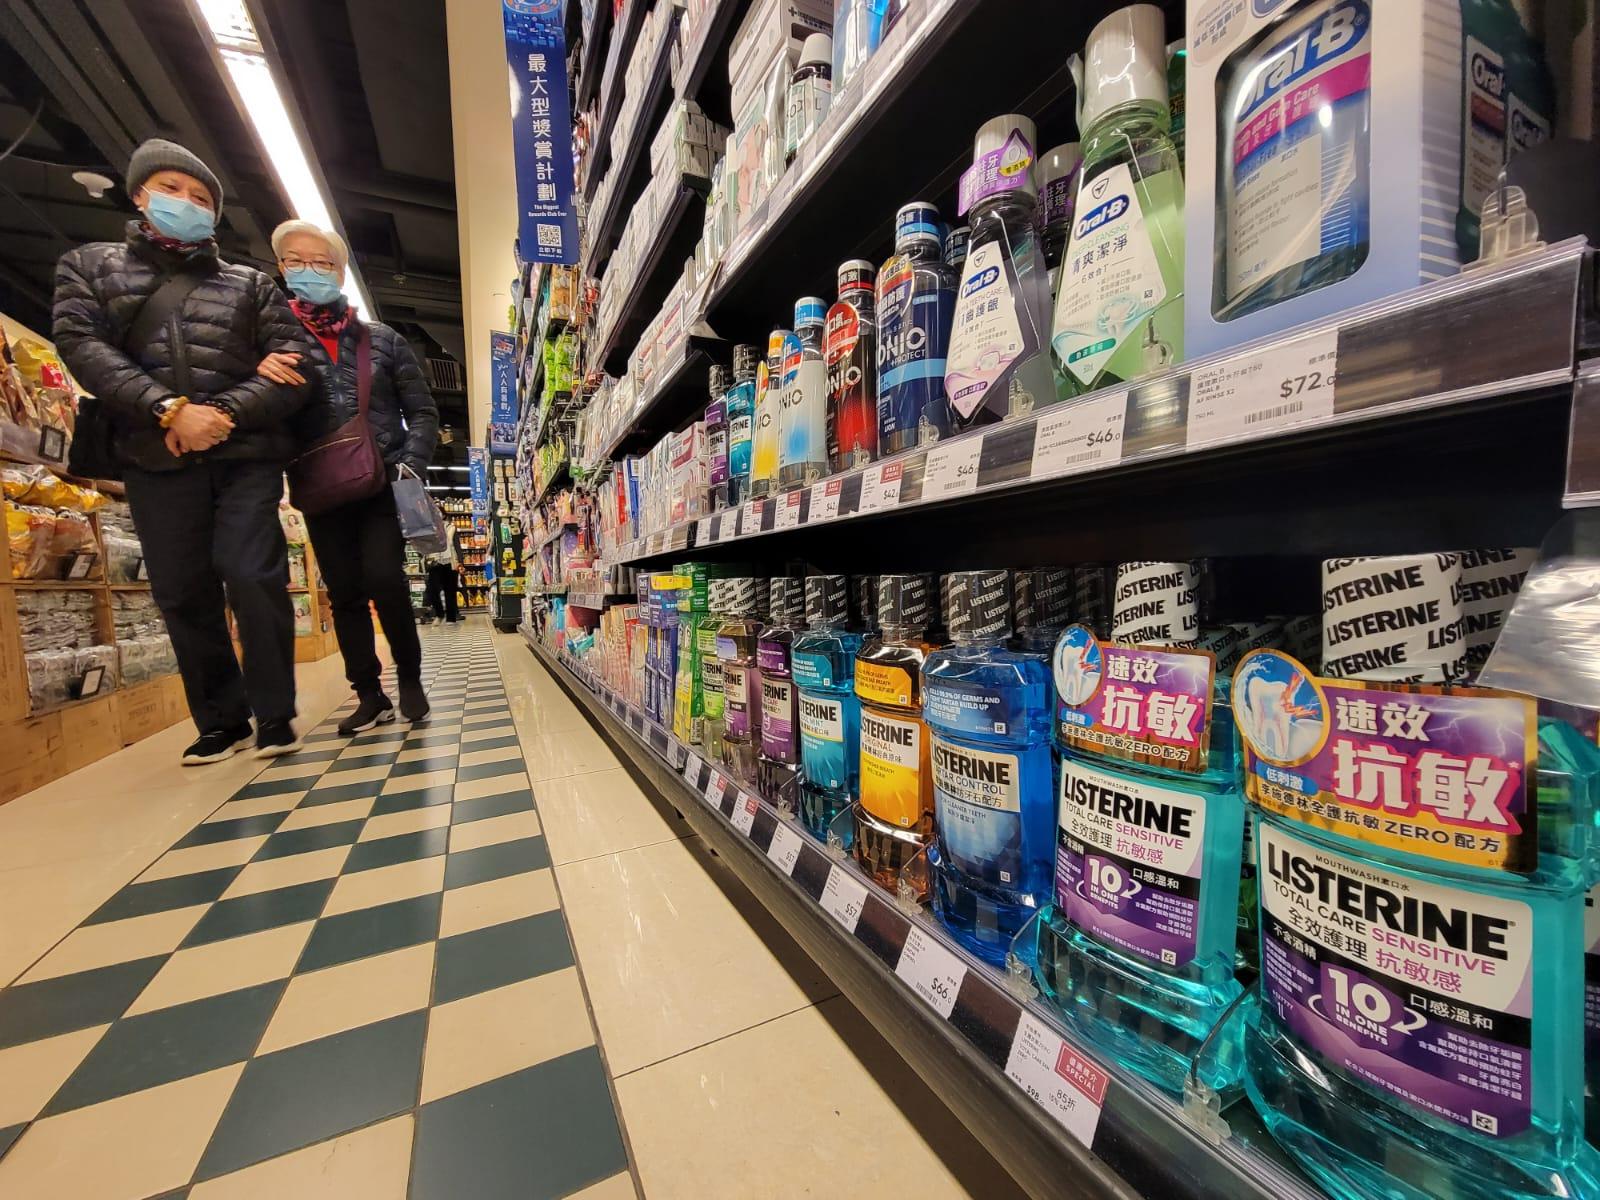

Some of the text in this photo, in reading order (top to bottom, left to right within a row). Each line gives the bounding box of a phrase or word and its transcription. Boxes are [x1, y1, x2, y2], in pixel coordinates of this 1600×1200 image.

[527, 53, 557, 201] 最大型獎賞計劃
[1075, 199, 1127, 239] Oral-B
[963, 268, 997, 297] Oral-B
[970, 588, 1005, 606] LISTERINE
[1117, 570, 1184, 603] LISTERINE
[1327, 599, 1440, 646] LISTERINE
[1108, 654, 1160, 684] 速效
[959, 701, 978, 709] BUILD
[979, 703, 989, 711] UP
[961, 694, 984, 703] GERMS
[984, 696, 1000, 704] AND
[1102, 685, 1199, 741] 抗敏
[1336, 696, 1431, 742] 速效
[956, 775, 1005, 796] CONTROL
[1266, 767, 1304, 792] 低刺激
[1333, 738, 1508, 826] 抗敏
[1064, 773, 1193, 838] LISTERINE
[1065, 801, 1183, 850] TOTAL CARE SENSITIVE
[1071, 818, 1164, 864] 全效護理 抗敏感
[1089, 858, 1122, 893] 10
[1133, 868, 1179, 890] 口感溫和
[1090, 892, 1118, 910] BENEFITS
[1091, 885, 1118, 903] IN ONE
[1268, 842, 1508, 960] LISTERINE
[1273, 880, 1496, 976] TOTAL CARE SENSITIVE
[1288, 906, 1462, 994] 全效護理 抗敏感
[1328, 968, 1391, 1023] 10
[1410, 993, 1493, 1030] 口感溫和
[1336, 1003, 1388, 1037] IN ONE
[1336, 1013, 1388, 1046] BENEFITS
[1066, 1065, 1096, 1093] SPECIAL
